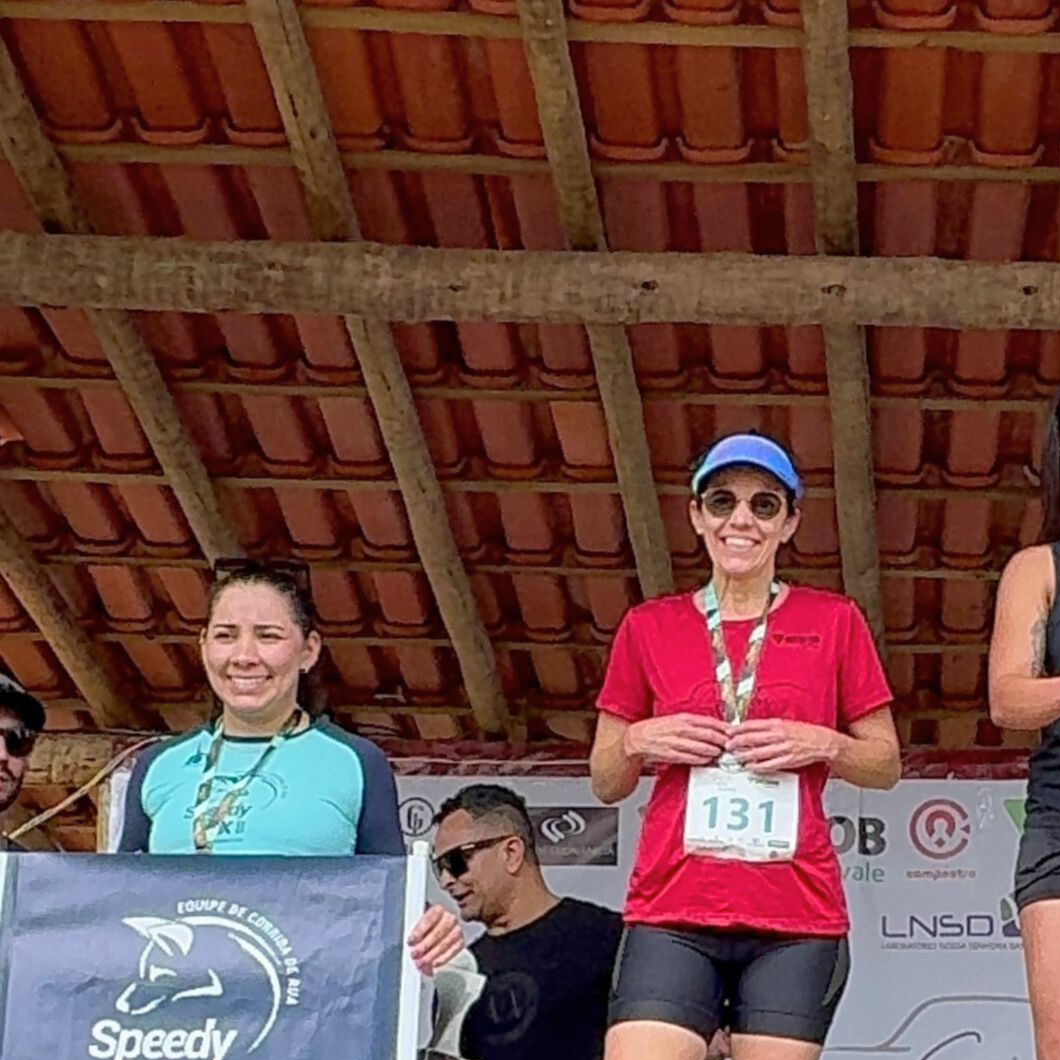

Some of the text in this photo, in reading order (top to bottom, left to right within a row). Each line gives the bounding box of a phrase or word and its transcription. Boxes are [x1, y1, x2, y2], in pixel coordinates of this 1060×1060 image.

[702, 796, 775, 833] 131
[881, 914, 995, 938] LNSD
[177, 899, 301, 1006] EQUIPE DE CORRIDA DE RUA
